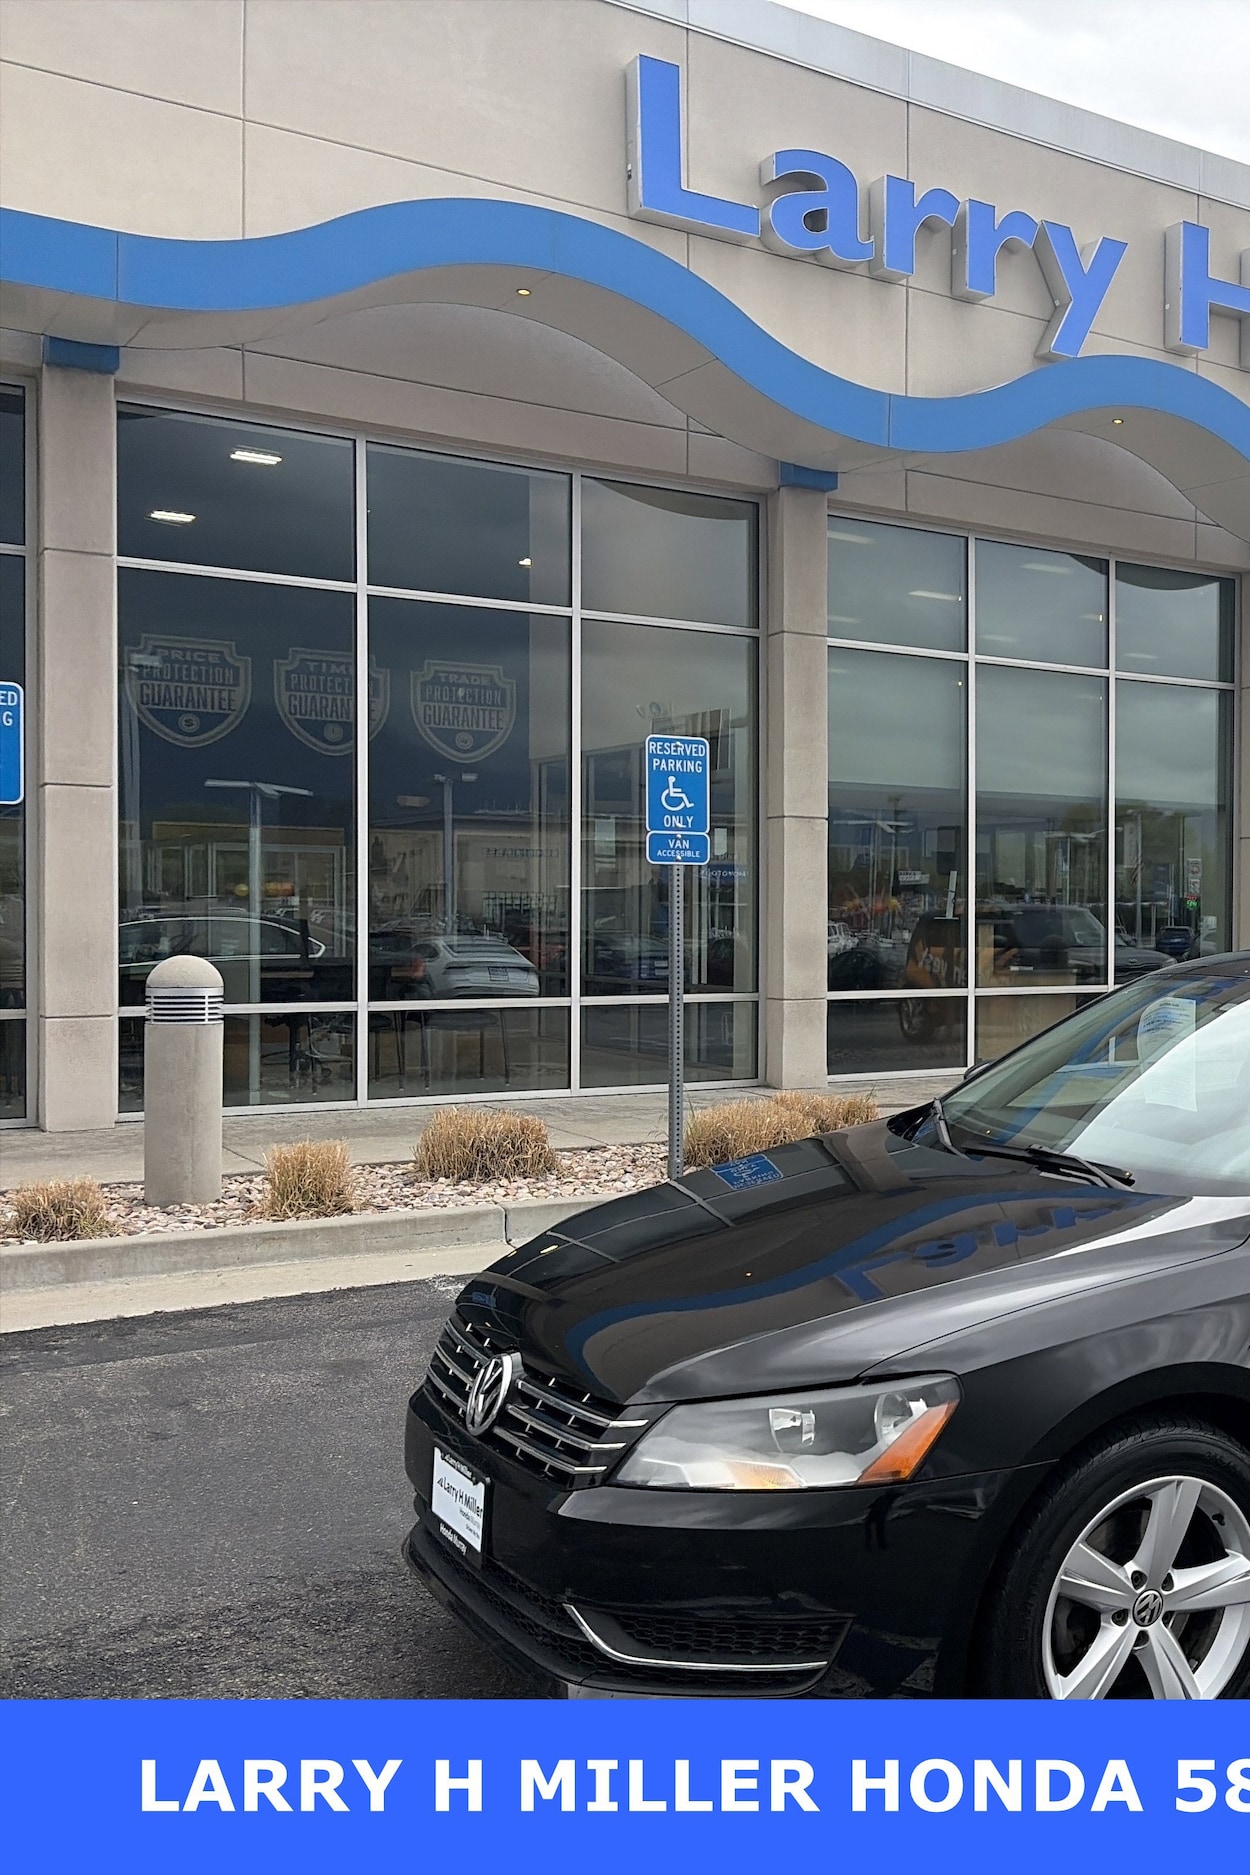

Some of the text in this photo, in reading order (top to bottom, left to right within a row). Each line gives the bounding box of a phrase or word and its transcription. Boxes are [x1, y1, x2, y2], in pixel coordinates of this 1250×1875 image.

[628, 53, 1128, 360] Larry
[155, 650, 221, 664] PRICE
[142, 663, 234, 685] PROTECTION
[306, 662, 356, 675] TIM
[290, 674, 374, 695] PROTECT
[437, 673, 492, 686] TRADE
[139, 682, 237, 713] GUARANTEE
[425, 684, 501, 705] PROTECTION
[288, 694, 376, 722] GUARANE
[423, 703, 504, 730] GUARANTEE
[649, 741, 705, 757] RESERVED
[653, 758, 702, 773] PARKING
[663, 815, 693, 828] ONLY
[668, 839, 690, 849] VAN
[656, 849, 700, 858] ACCESSIBLE
[443, 1476, 459, 1502] Larry
[464, 1493, 483, 1519] Miller
